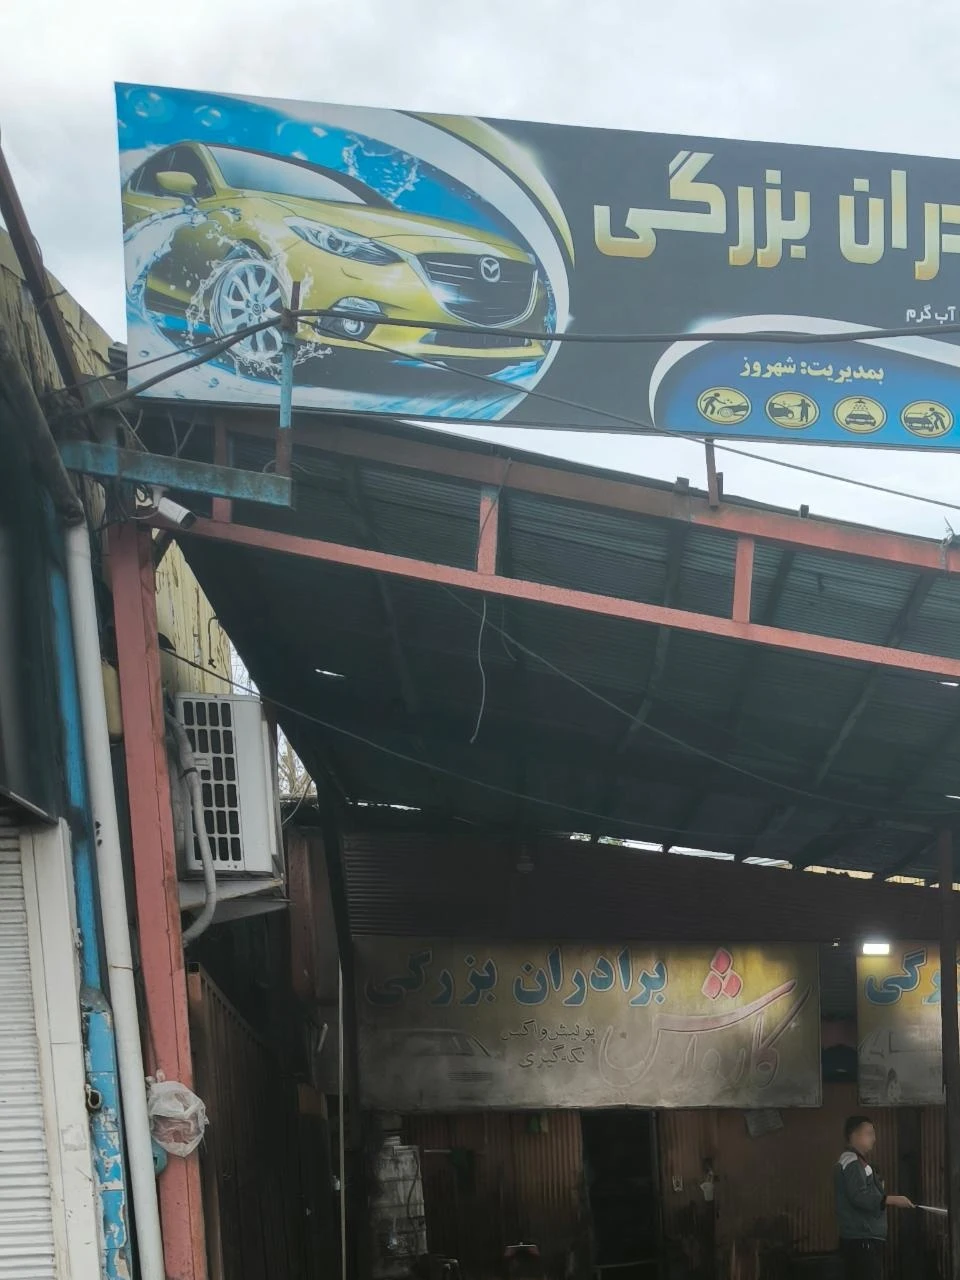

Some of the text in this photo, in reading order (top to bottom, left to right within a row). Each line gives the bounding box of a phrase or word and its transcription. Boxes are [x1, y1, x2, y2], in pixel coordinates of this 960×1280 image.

[593, 150, 811, 268] بزرگی
[905, 303, 932, 324] گرم
[934, 305, 957, 325] آب
[739, 356, 797, 379] شهروز
[364, 945, 668, 1008] برادران بزرگی
